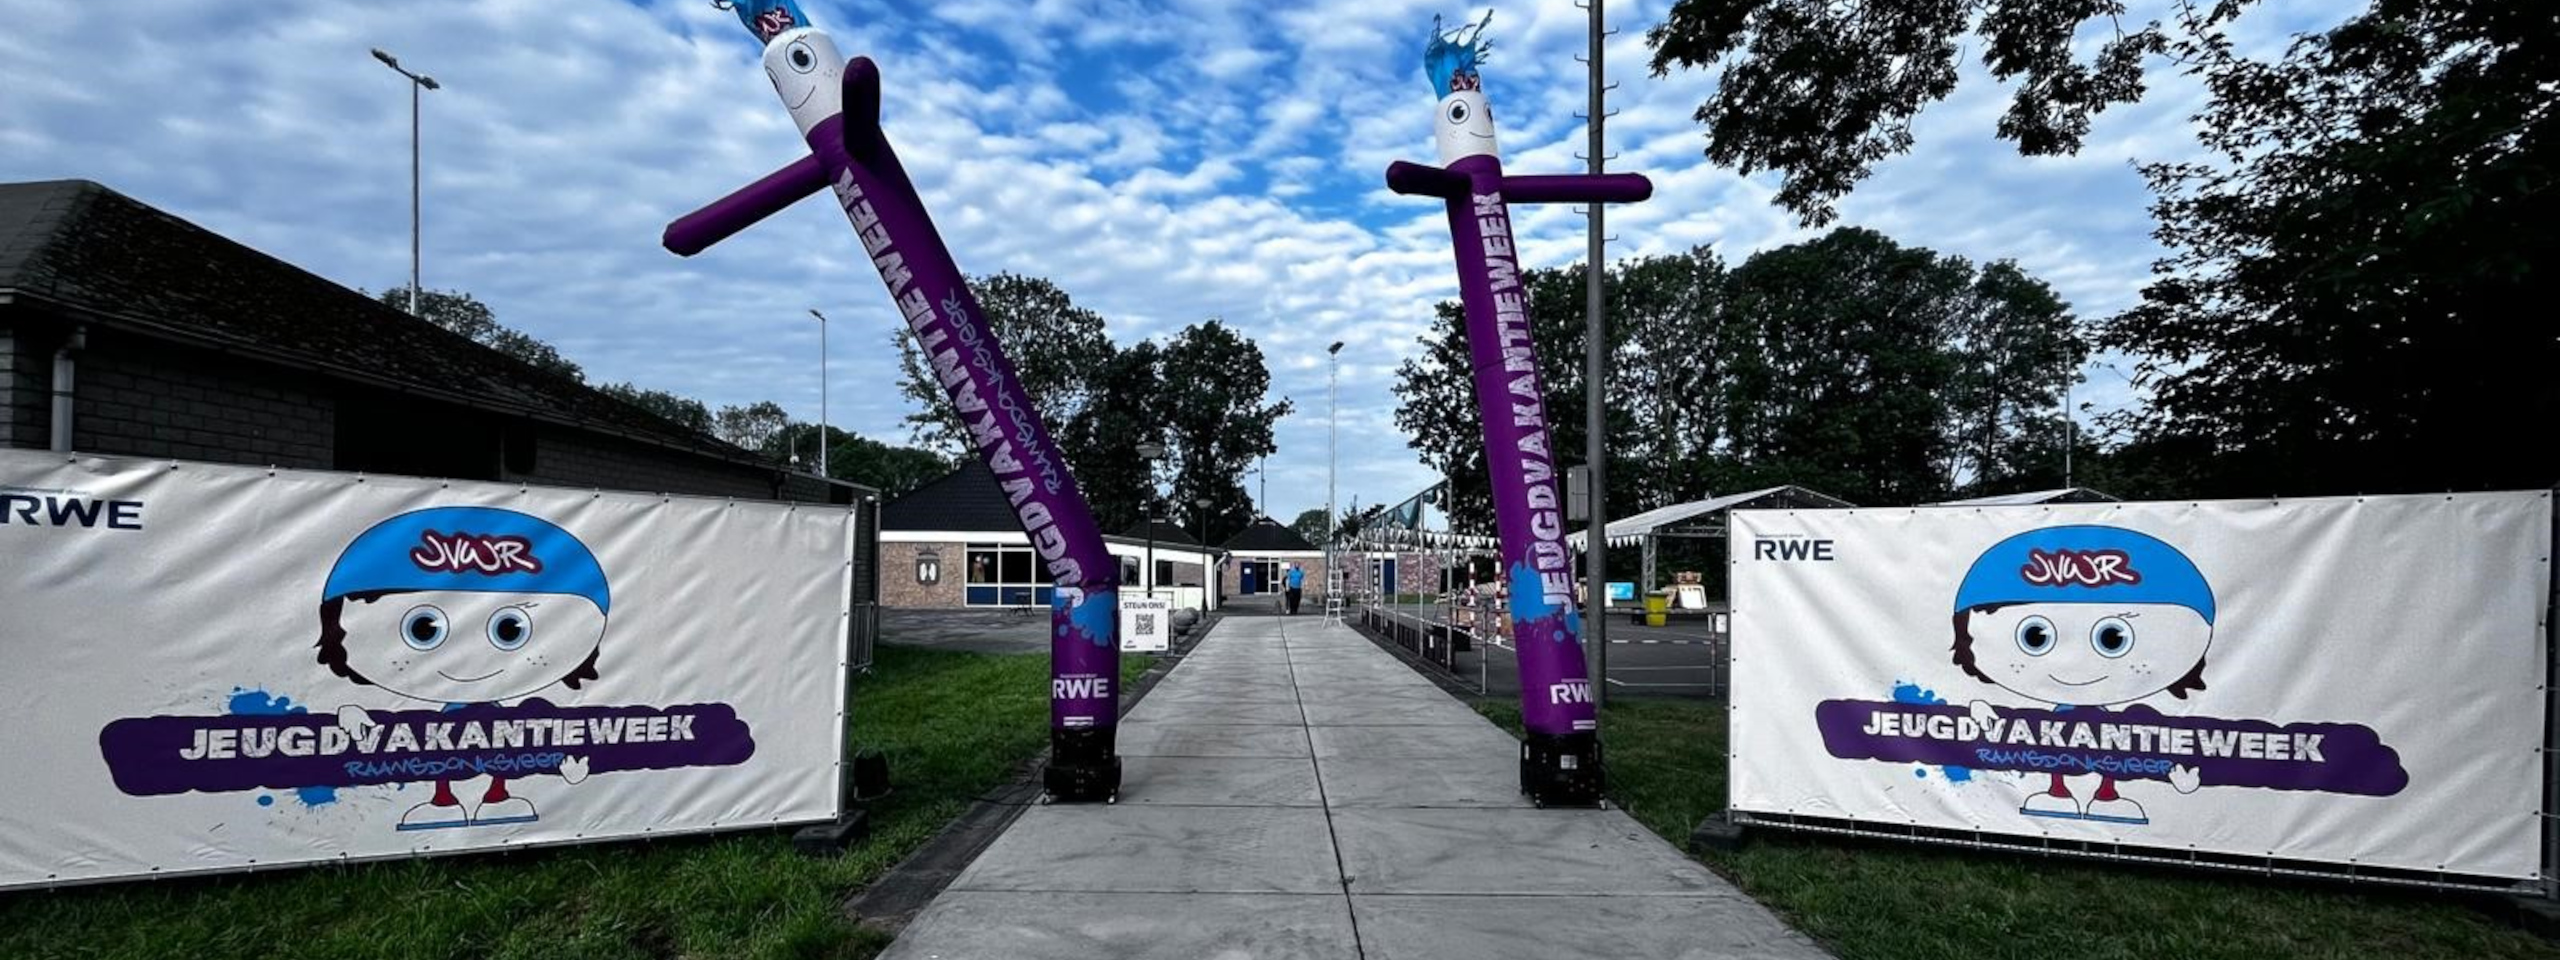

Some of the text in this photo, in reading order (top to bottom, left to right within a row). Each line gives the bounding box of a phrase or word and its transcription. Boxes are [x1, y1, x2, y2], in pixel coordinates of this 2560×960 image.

[1472, 190, 1573, 615] JEUGDVAKANTIEWEEK
[0, 494, 143, 530] RWE
[415, 535, 535, 572] JVWR
[1755, 540, 1834, 560] RWE
[2025, 553, 2134, 584] JVWR
[1053, 678, 1109, 699] RWE
[180, 713, 695, 760] JEUGDVAKANTIEWEEK
[1863, 711, 2325, 763] JEUGDVAKANTIEWEEK
